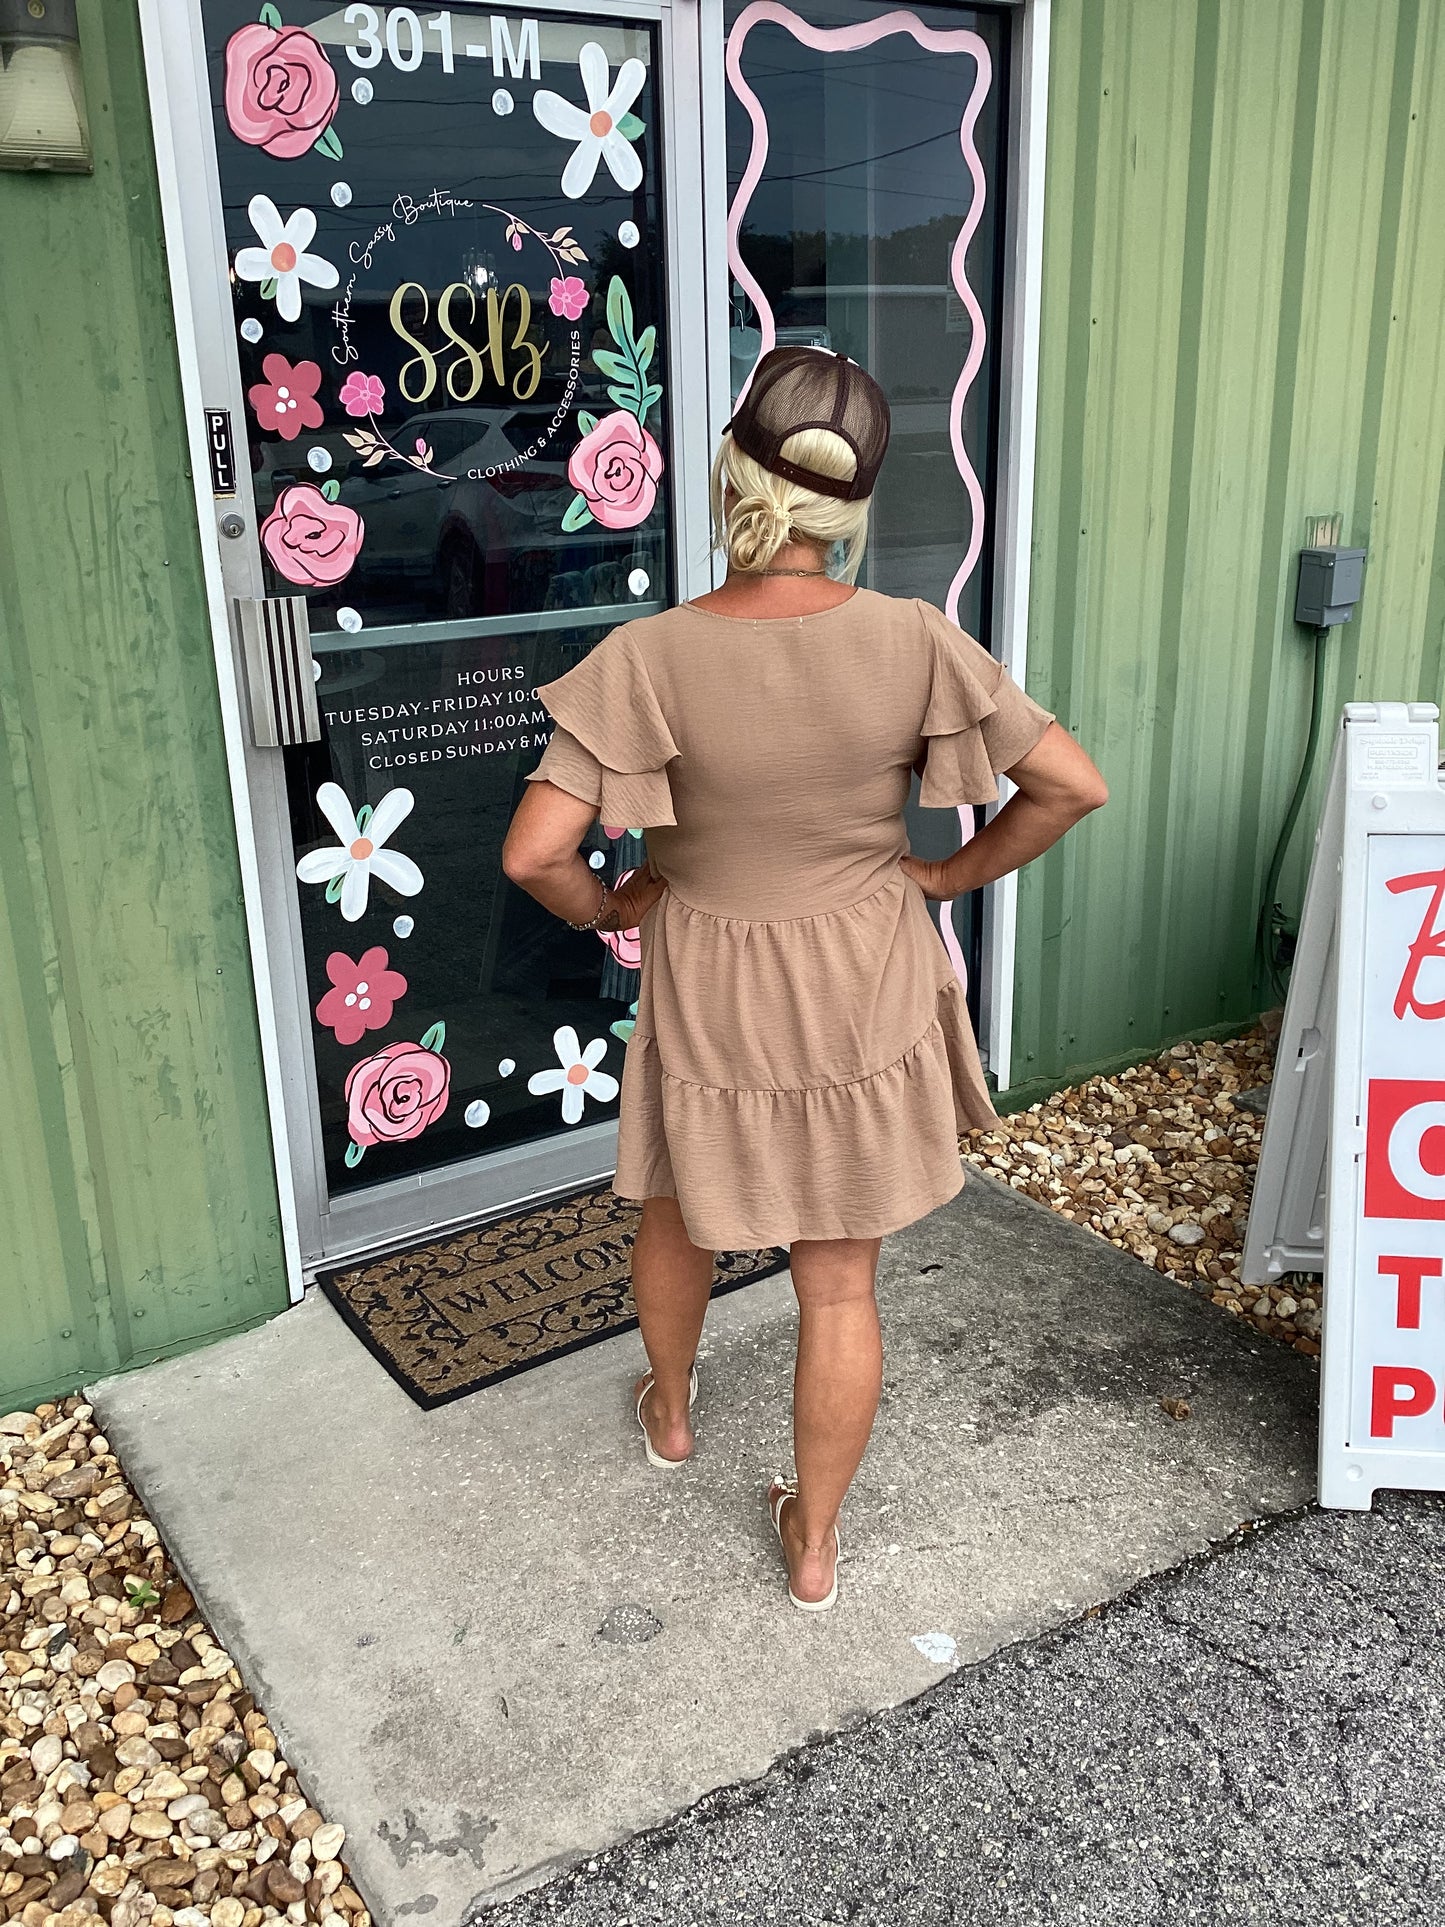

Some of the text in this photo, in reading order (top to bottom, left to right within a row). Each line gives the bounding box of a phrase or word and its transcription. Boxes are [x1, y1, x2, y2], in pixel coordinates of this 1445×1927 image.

[344, 3, 541, 80] 301-M
[332, 188, 474, 365] Southern Sassy Boutique
[389, 282, 550, 402] SSB
[467, 330, 581, 480] CLOTHING & ACCESSORIES
[211, 415, 229, 487] PULL
[325, 692, 503, 726] TUESDAY-FRIDAY
[457, 666, 525, 686] HOURS
[361, 719, 470, 746] SATURDAY
[520, 735, 530, 748] &
[1370, 1366, 1445, 1438] P
